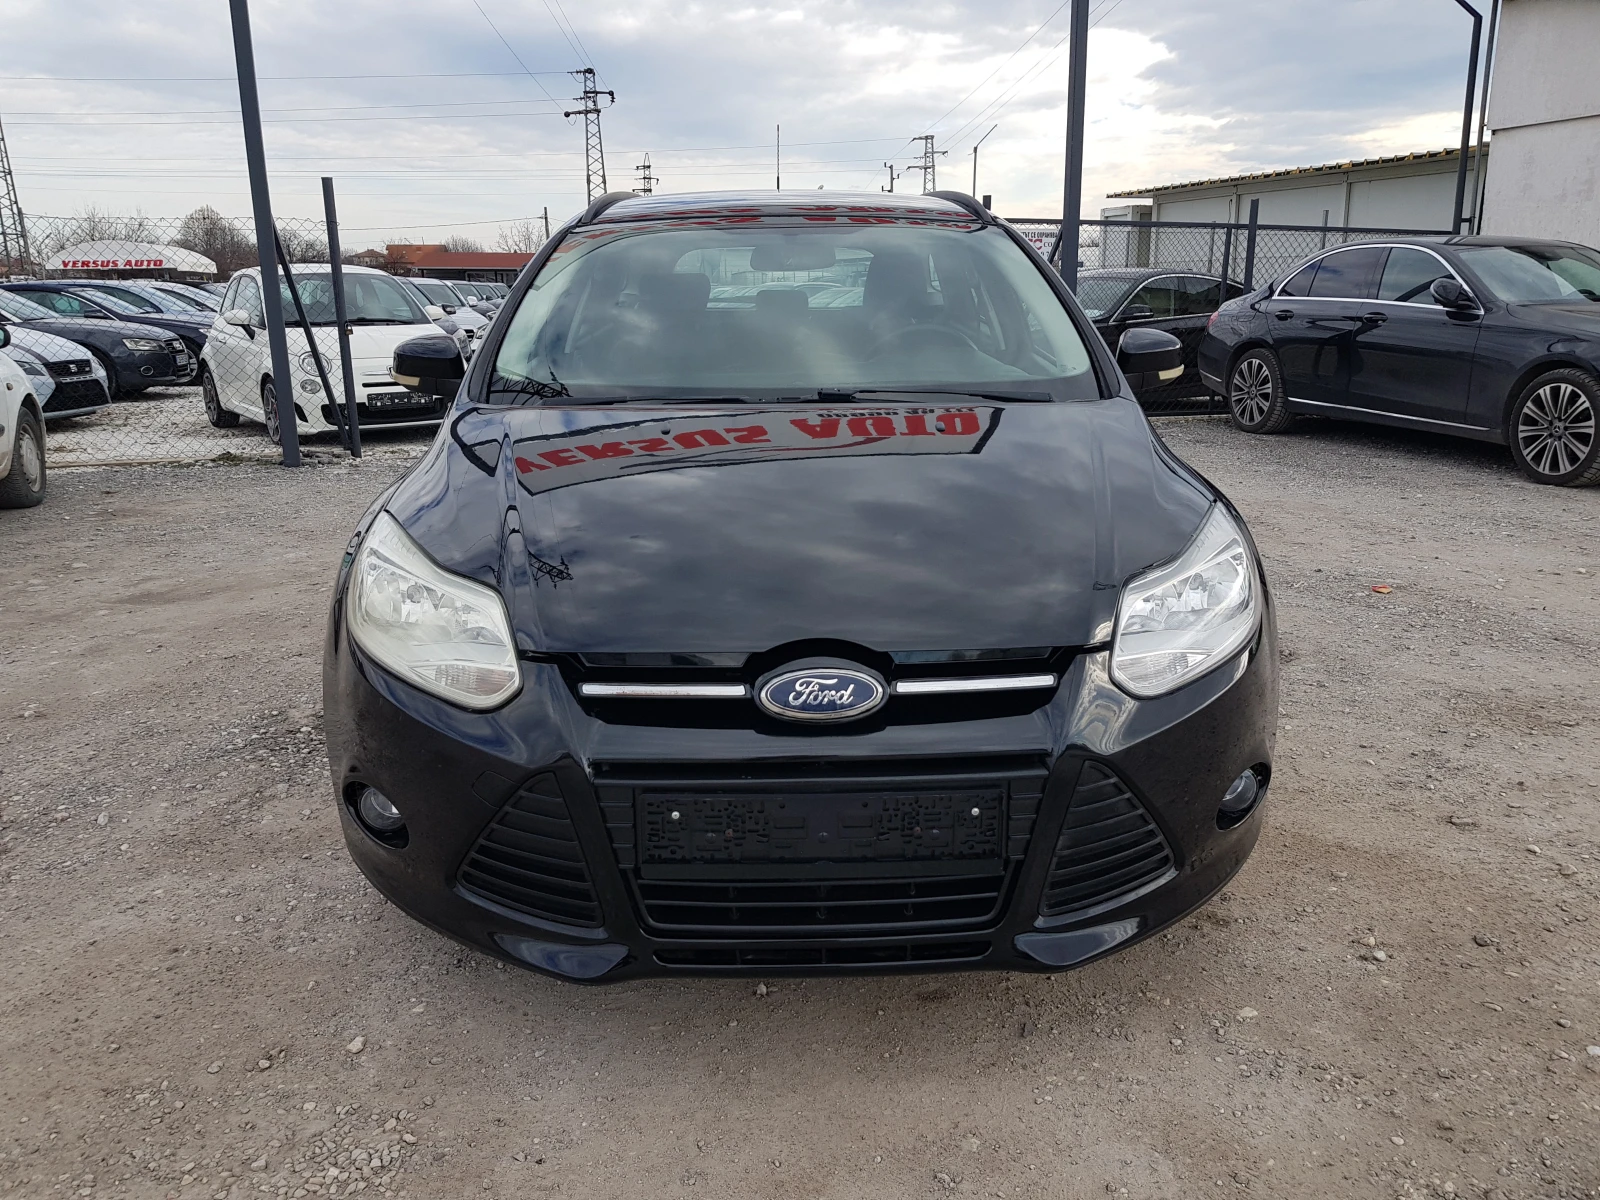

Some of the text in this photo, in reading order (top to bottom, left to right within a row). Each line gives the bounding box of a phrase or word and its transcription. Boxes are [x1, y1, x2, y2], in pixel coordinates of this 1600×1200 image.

[62, 259, 164, 268] VERSUS AUTO
[788, 678, 855, 706] Ford
